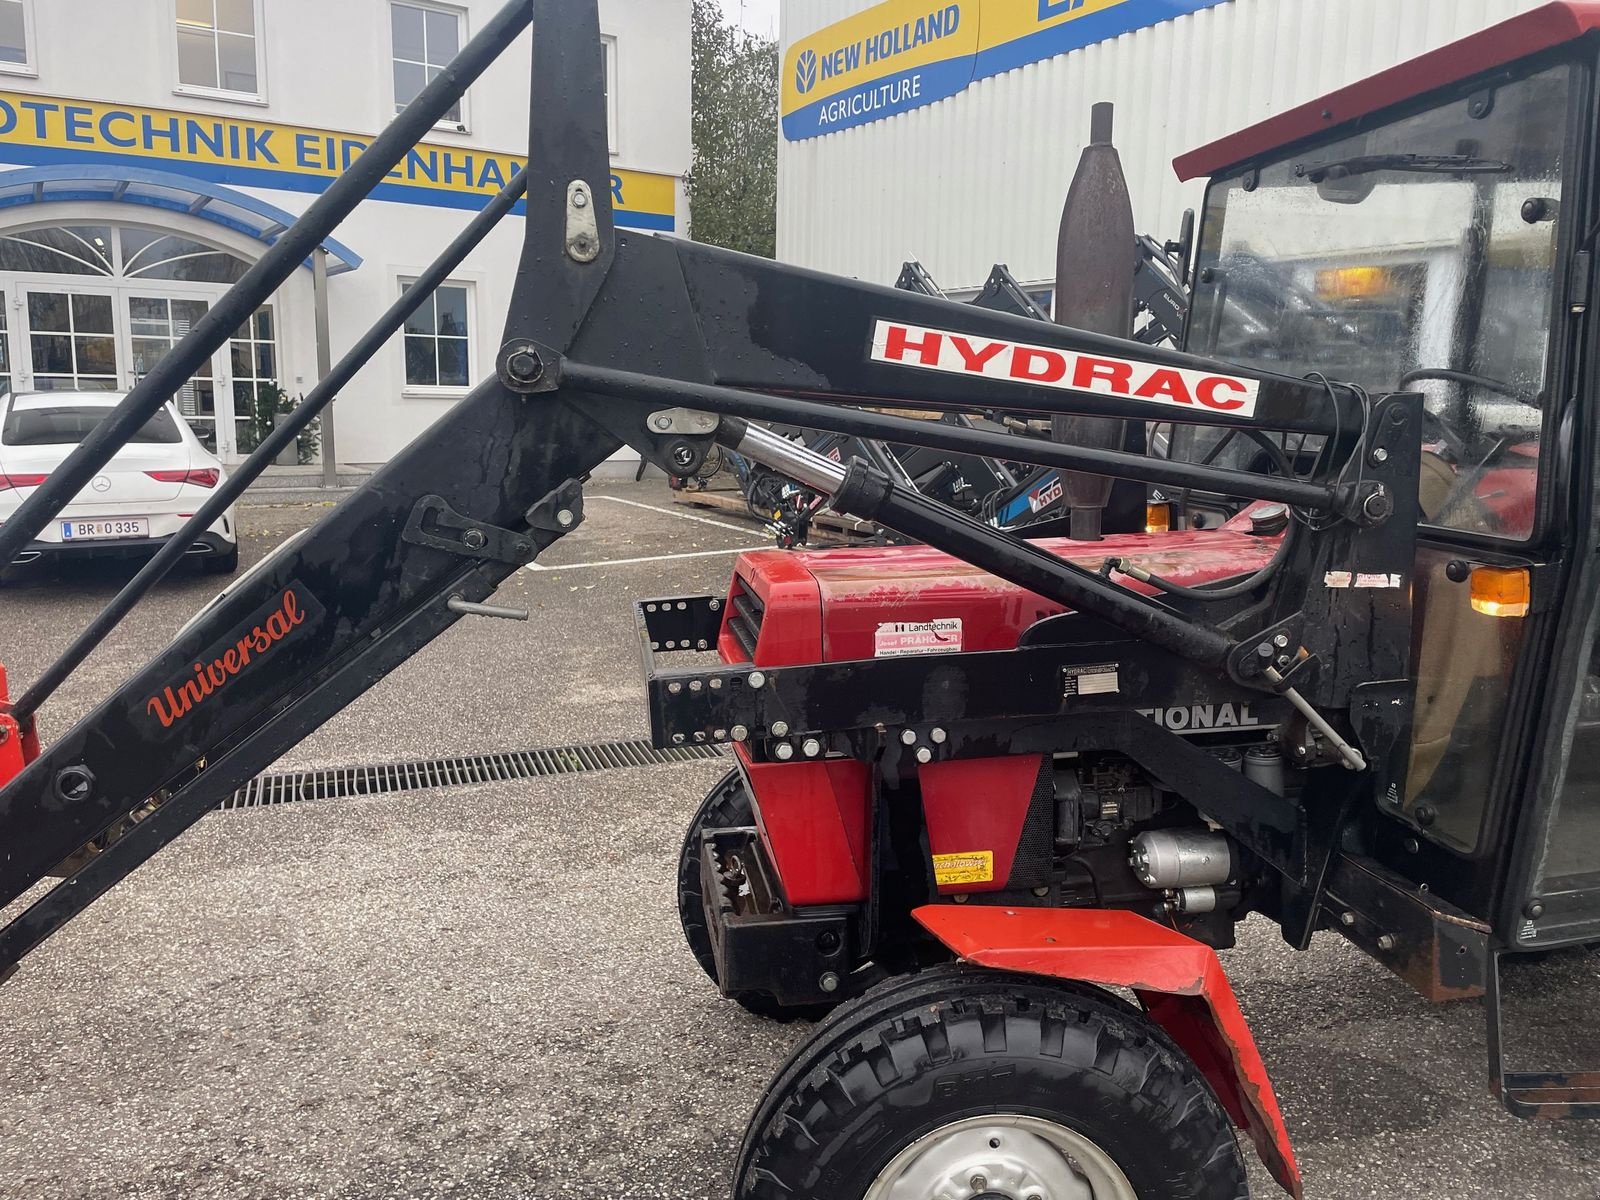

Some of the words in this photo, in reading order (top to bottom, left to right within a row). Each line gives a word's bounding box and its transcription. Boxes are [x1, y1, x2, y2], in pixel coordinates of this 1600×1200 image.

[821, 42, 862, 80] NEW
[865, 4, 960, 64] HOLLAND
[818, 75, 921, 126] AGRICULTURE
[884, 325, 1248, 411] HYDRAC
[78, 523, 95, 535] BR
[900, 632, 958, 645] PRÄHOER
[908, 621, 958, 632] Landtechnik
[147, 589, 305, 727] Universal
